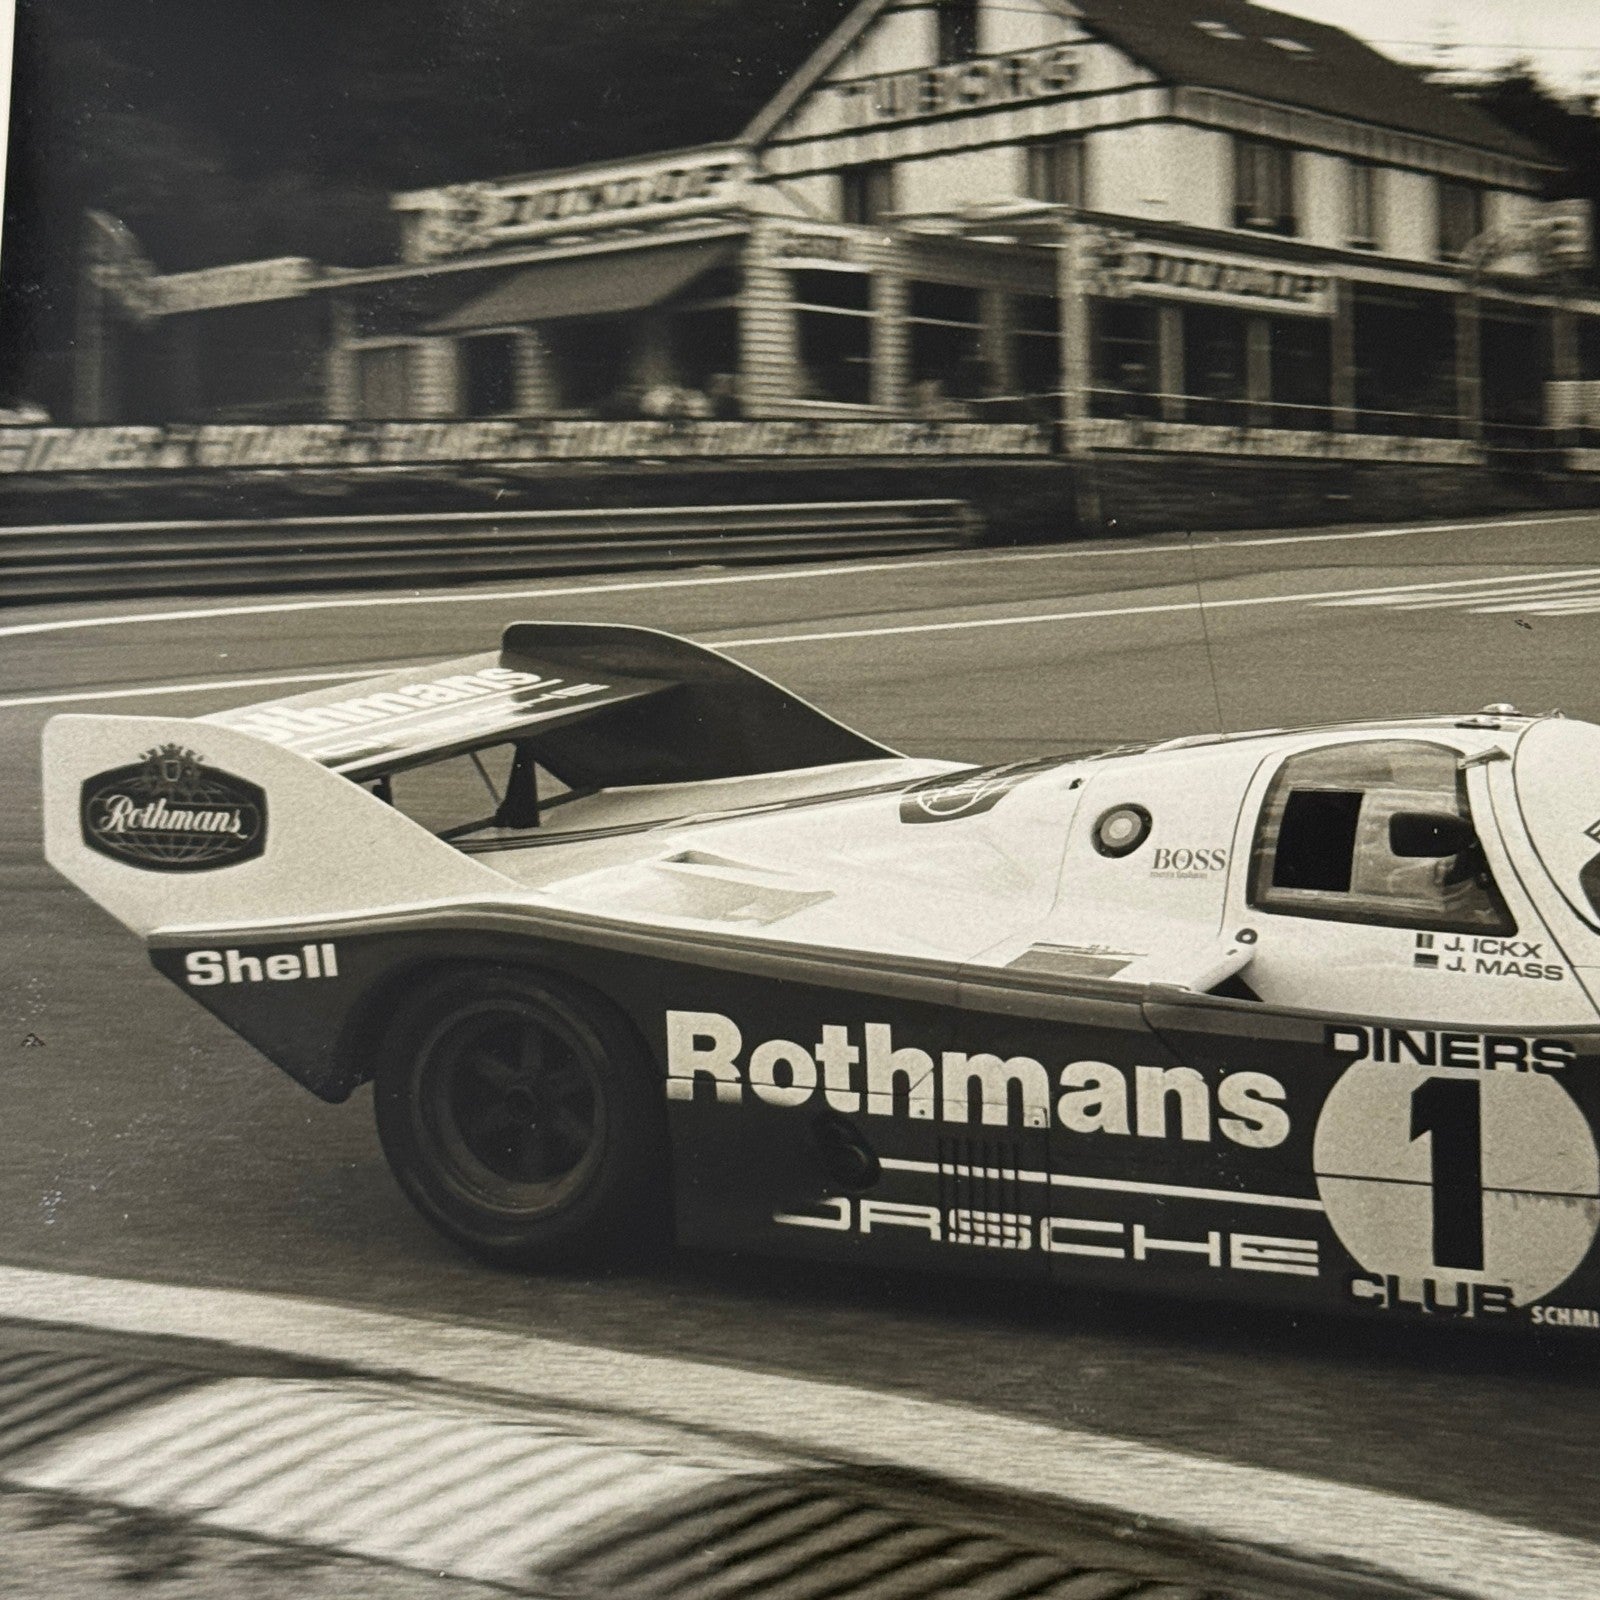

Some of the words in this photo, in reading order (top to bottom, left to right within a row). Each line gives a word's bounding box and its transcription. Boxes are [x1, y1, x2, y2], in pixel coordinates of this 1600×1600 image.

[100, 794, 248, 839] Rothmans
[1152, 848, 1227, 871] BOSS
[185, 943, 338, 986] Shell
[1444, 936, 1465, 952] J.
[1472, 938, 1543, 959] ICKX
[1445, 957, 1466, 973] J.
[1475, 958, 1564, 981] MASS
[1323, 1023, 1576, 1075] DINERS
[665, 1009, 1291, 1149] Rothmans
[1409, 1075, 1485, 1271] 1
[1343, 1271, 1516, 1322] CLUB
